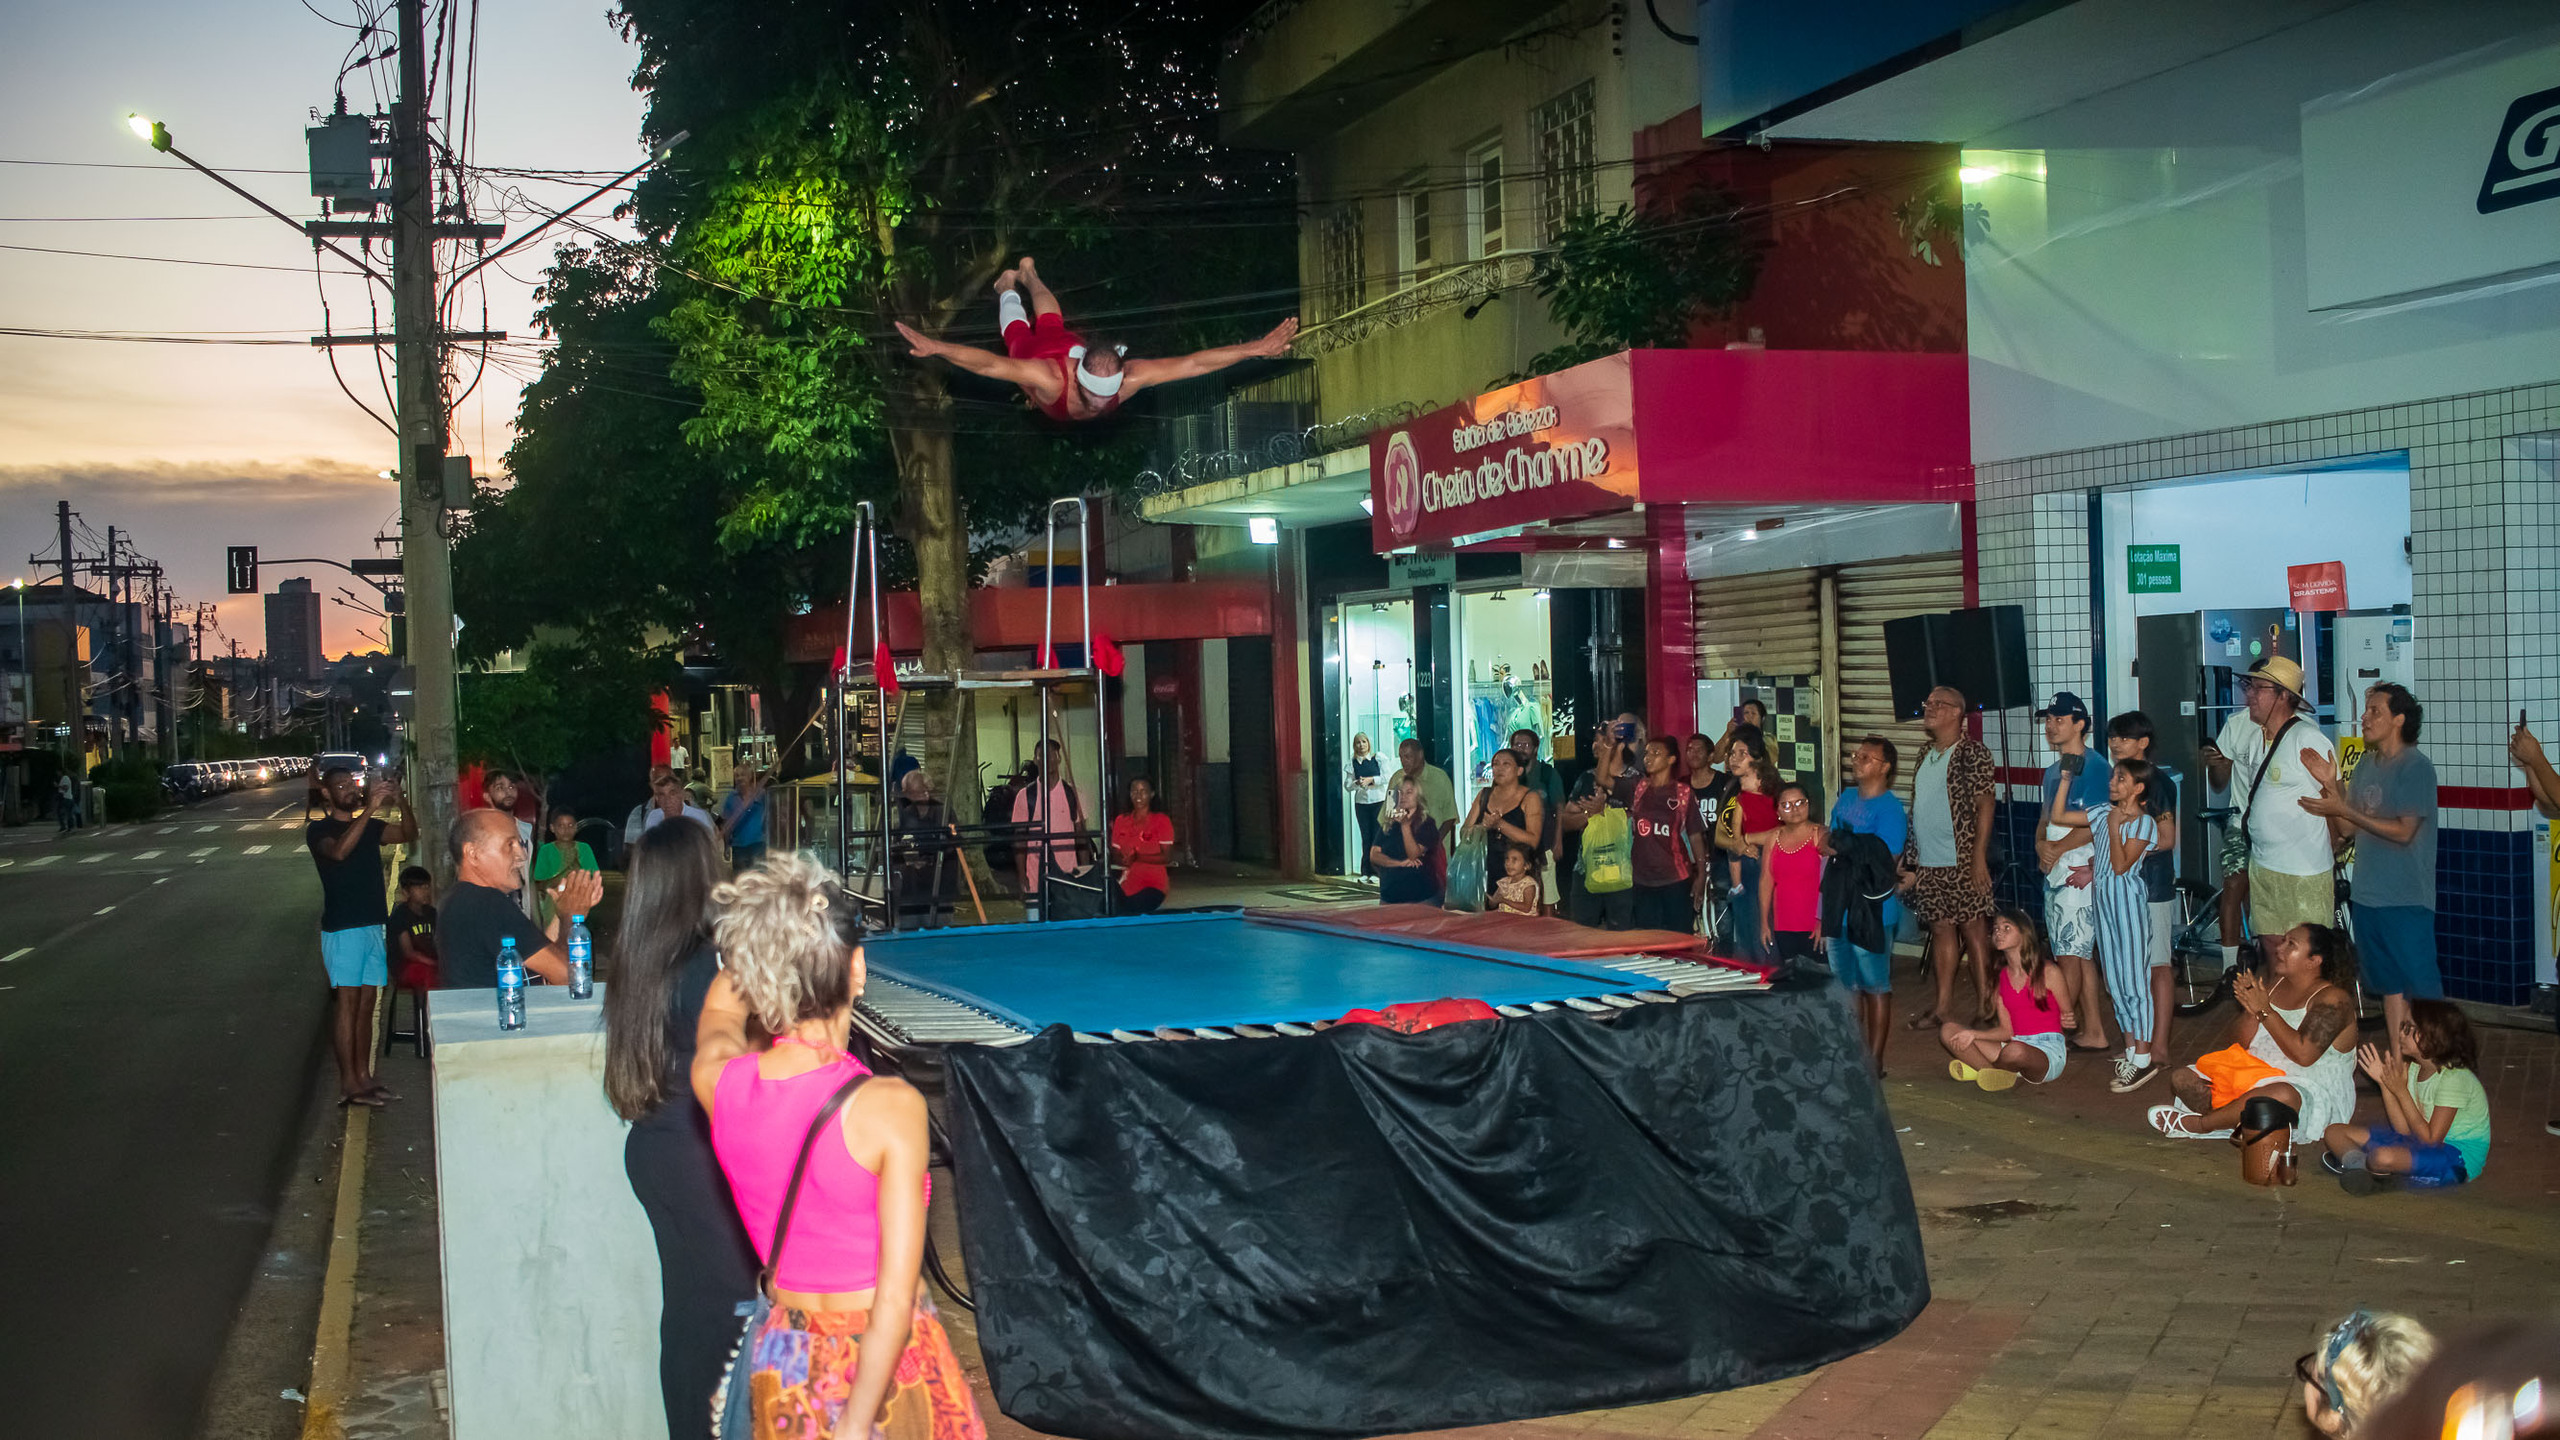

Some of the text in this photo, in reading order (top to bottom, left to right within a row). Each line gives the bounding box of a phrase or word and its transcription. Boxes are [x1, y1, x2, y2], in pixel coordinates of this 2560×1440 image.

[1453, 405, 1556, 454] Salão de Beleza
[1422, 437, 1608, 513] Cheia de Charme
[2154, 549, 2177, 562] Máxima
[2136, 572, 2172, 588] 301 pessoas
[2293, 587, 2337, 597] BRASTEMP
[1417, 671, 1432, 688] 1223
[1654, 822, 1670, 837] LG
